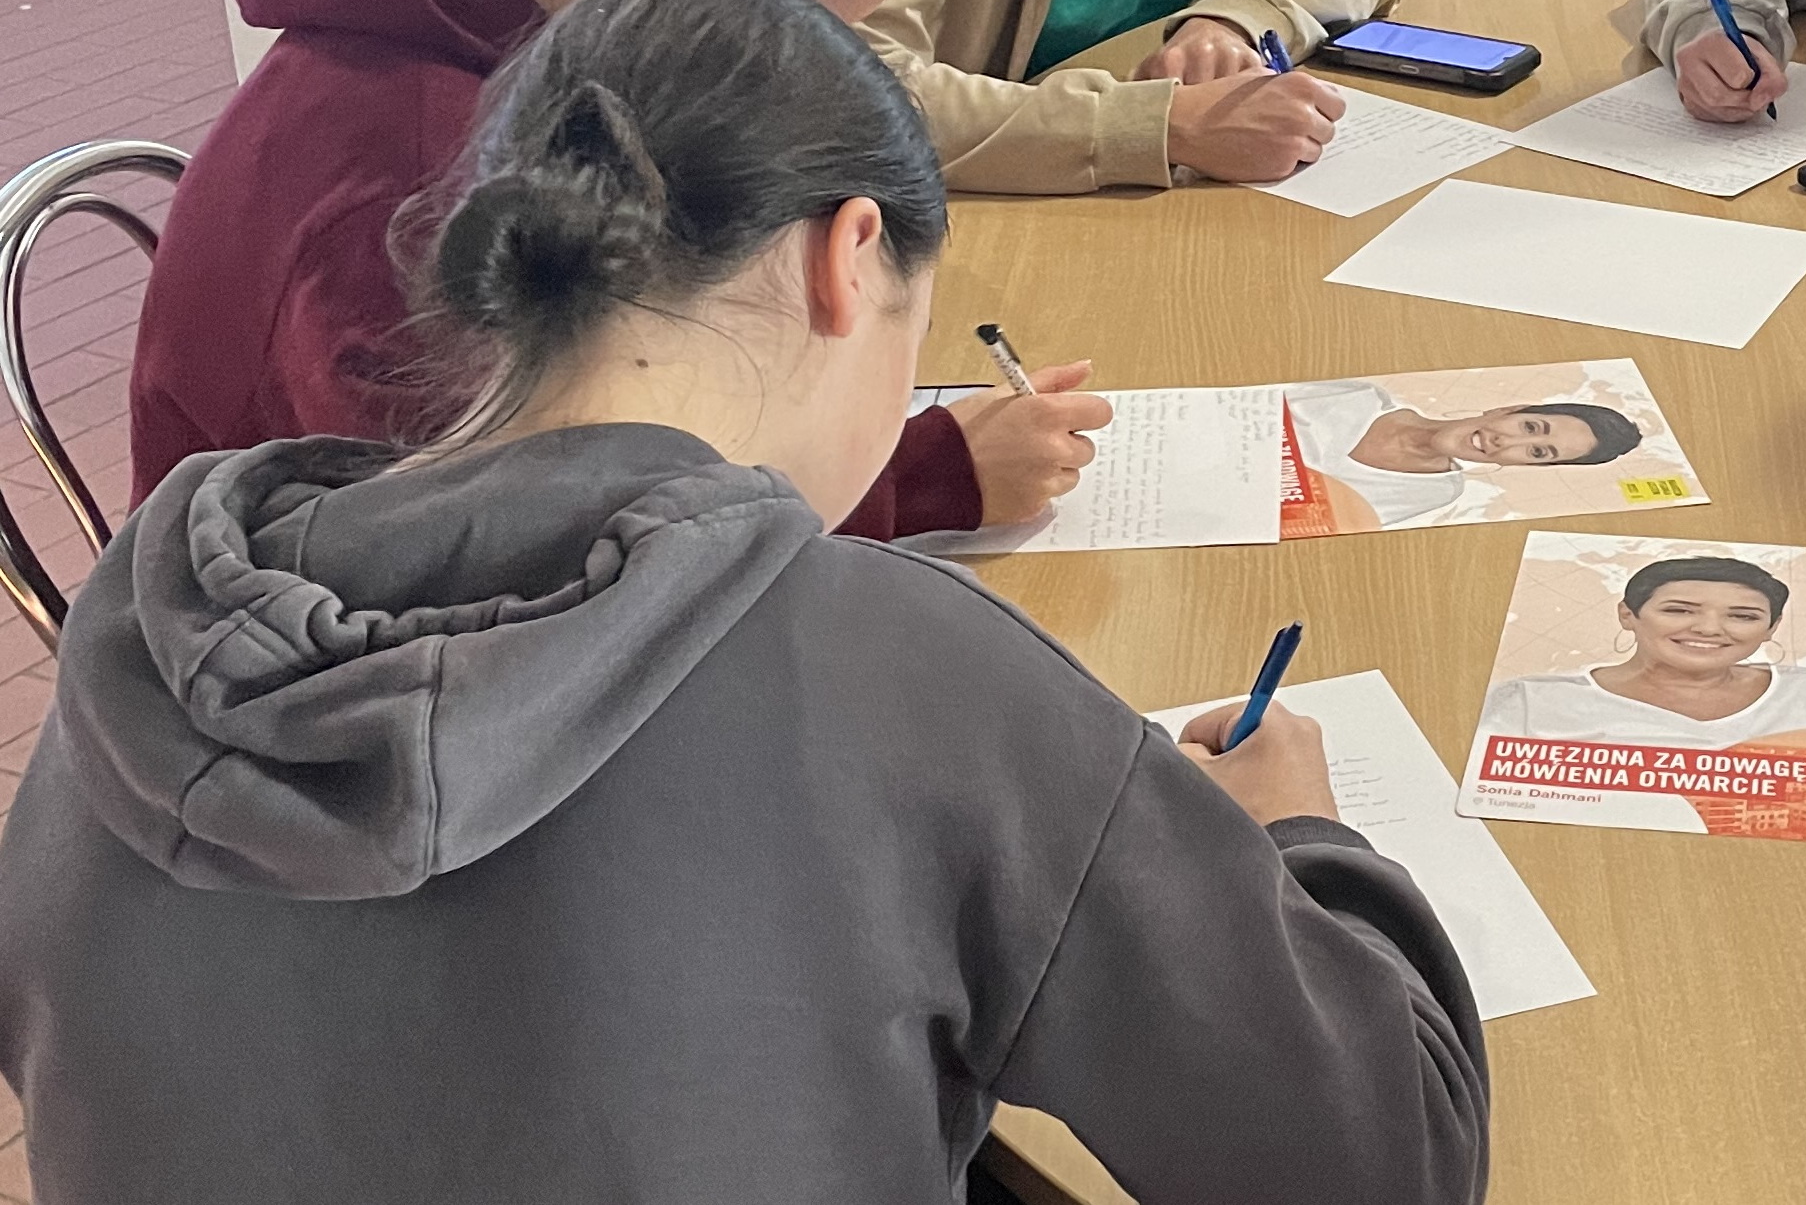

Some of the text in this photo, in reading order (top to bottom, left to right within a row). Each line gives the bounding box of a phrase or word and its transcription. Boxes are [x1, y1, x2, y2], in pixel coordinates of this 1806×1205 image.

[1495, 741, 1645, 766] UWIĘZIONA
[1654, 751, 1687, 769] ZA
[1490, 758, 1777, 796] MÓWIENIA OTWARCIE
[1476, 784, 1602, 802] Sonia Dahmani
